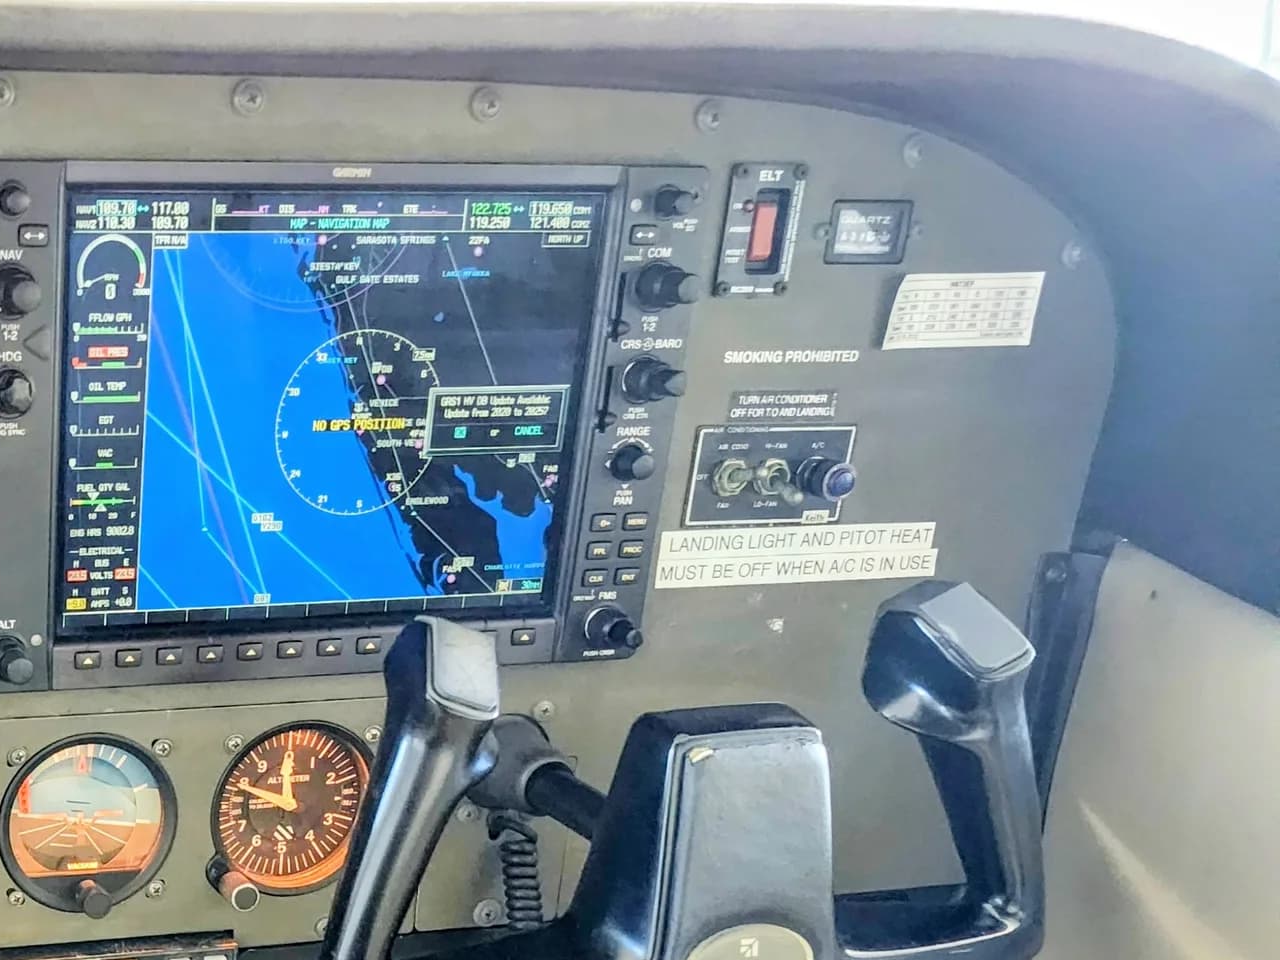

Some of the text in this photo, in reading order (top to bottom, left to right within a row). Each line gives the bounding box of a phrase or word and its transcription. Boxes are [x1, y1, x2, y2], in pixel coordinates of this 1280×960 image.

[759, 170, 784, 181] ELT
[471, 203, 512, 215] 122.725
[470, 217, 511, 229] 119.250
[0, 250, 23, 261] NAV
[647, 248, 672, 258] COM
[724, 350, 859, 363] SMOKING PROHIBITED
[330, 420, 351, 431] GPS
[354, 418, 406, 430] POSITION
[616, 427, 650, 437] RANGE
[669, 528, 933, 552] LANDING LIGHT AND PITOT HEAT
[659, 554, 932, 582] MUST BE OFF WHEN A/C IS IN USE
[598, 591, 617, 600] FMS
[257, 762, 268, 773] 9
[325, 772, 336, 785] 2
[323, 813, 333, 825] 3
[237, 820, 247, 832] 7
[252, 835, 262, 847] 6
[277, 842, 287, 854] 5
